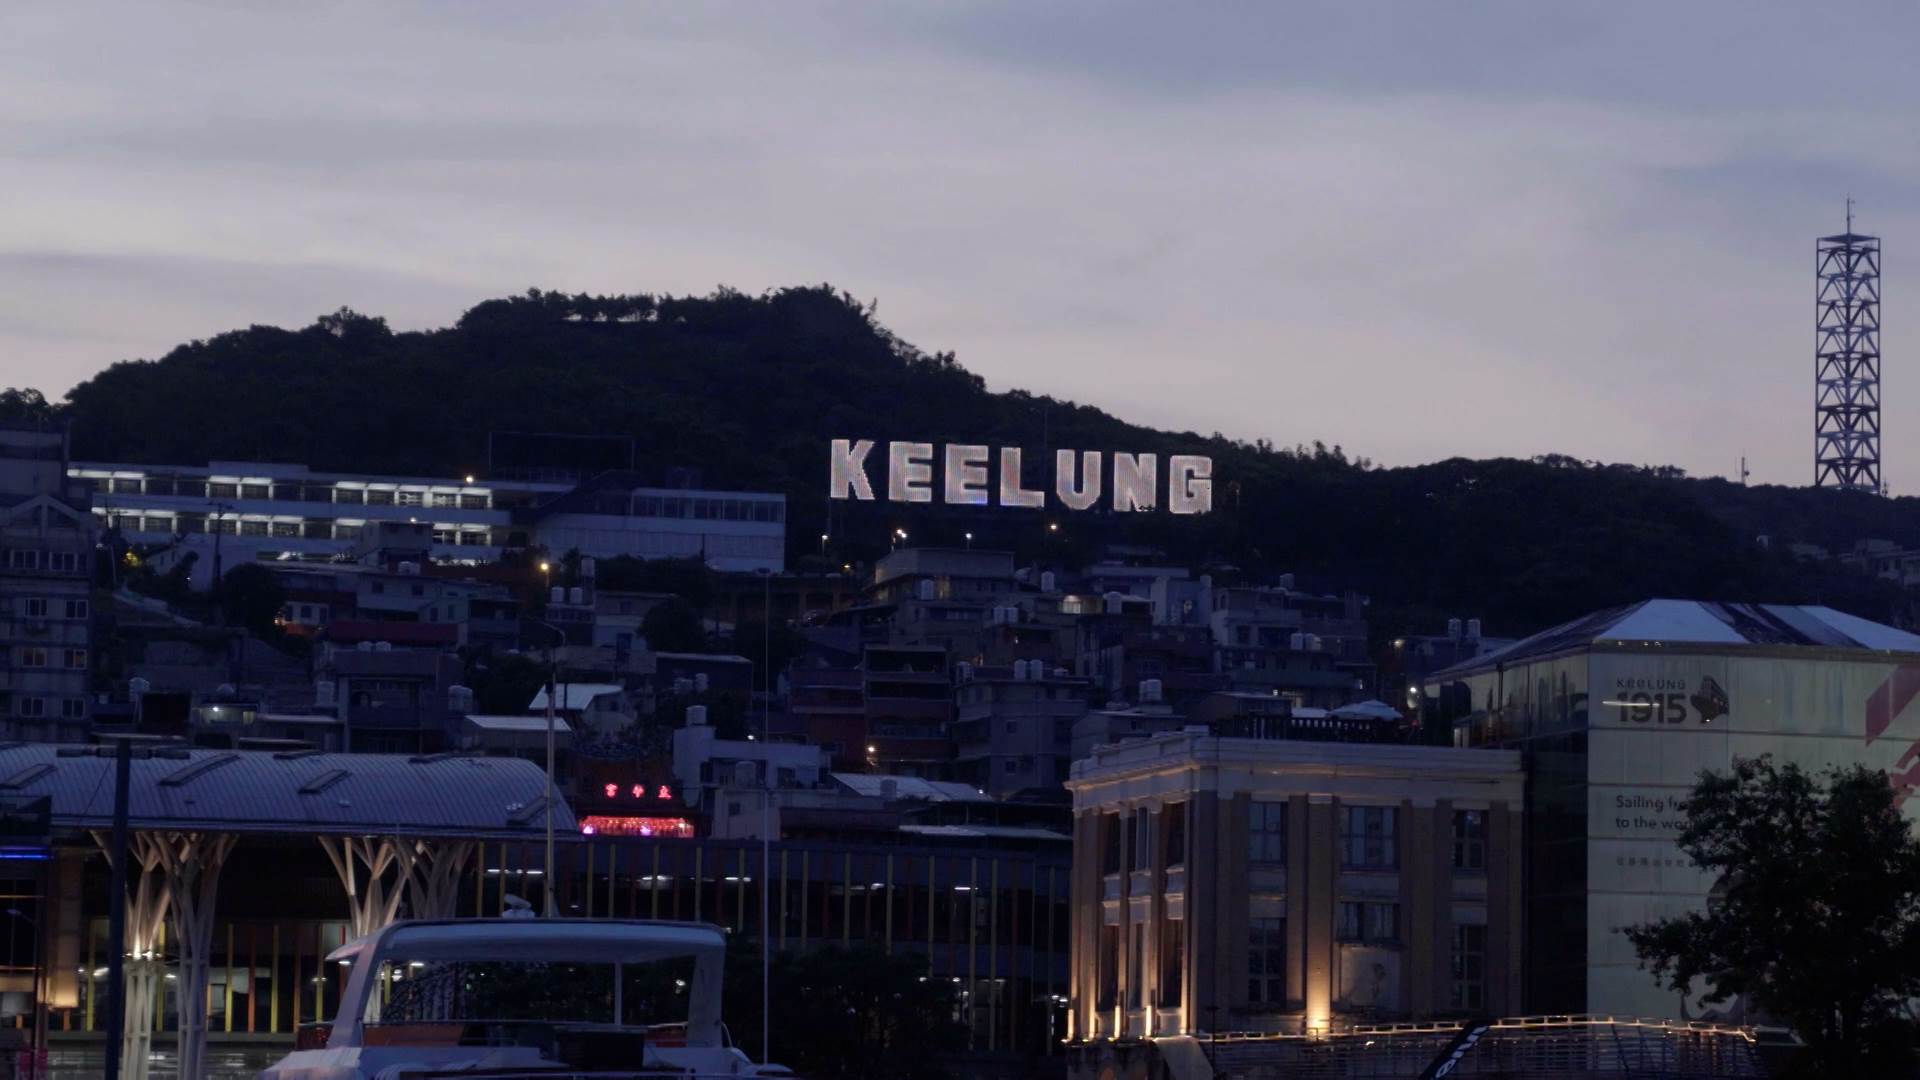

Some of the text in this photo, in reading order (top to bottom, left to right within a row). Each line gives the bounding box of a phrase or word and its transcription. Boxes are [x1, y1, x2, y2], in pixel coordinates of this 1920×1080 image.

[830, 439, 1213, 514] KEELUNG
[1616, 676, 1687, 690] KEELUNG
[1616, 691, 1688, 724] 1915
[1615, 794, 1664, 813] Sailing
[1615, 816, 1630, 829] to
[1634, 815, 1658, 830] the
